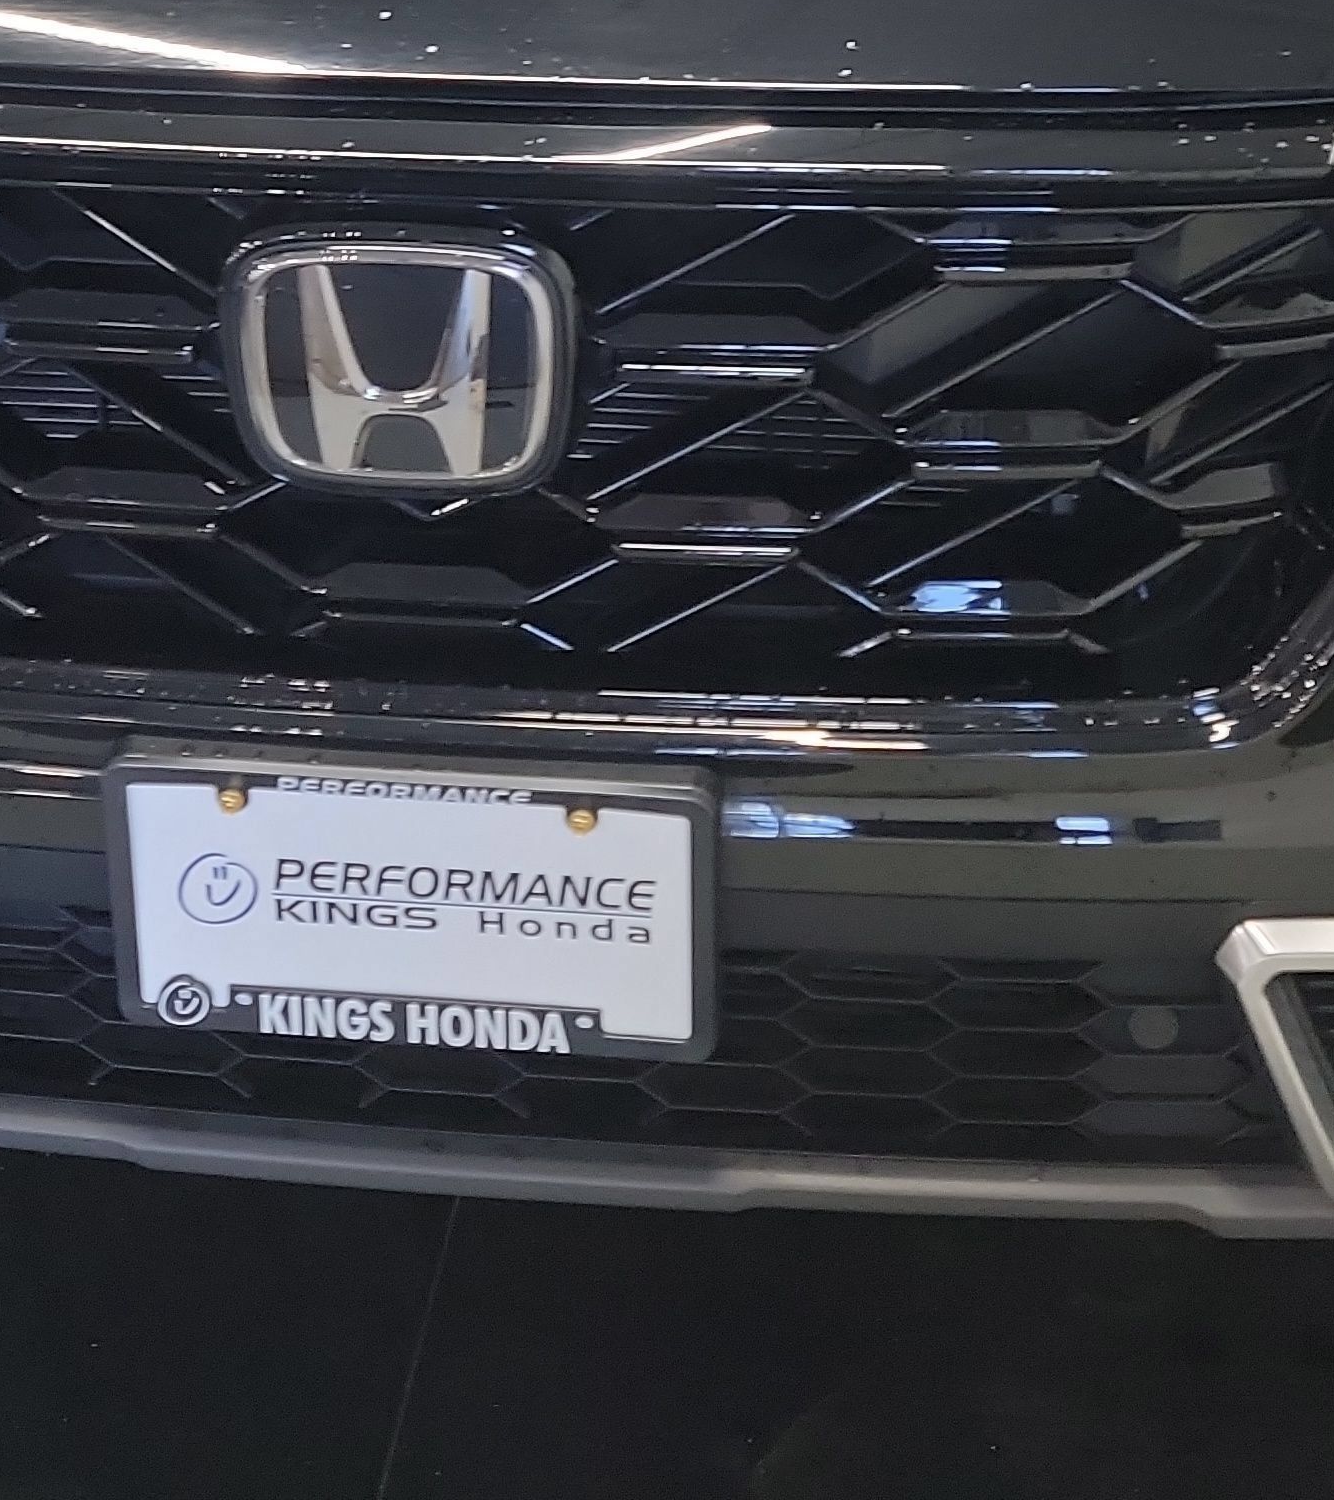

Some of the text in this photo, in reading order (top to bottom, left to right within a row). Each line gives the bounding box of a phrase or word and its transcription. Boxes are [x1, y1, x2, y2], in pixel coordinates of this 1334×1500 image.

[276, 775, 533, 805] PERFORMANCE
[274, 858, 657, 912] PERFORMANCE
[275, 898, 651, 944] KINGS Honda
[258, 992, 572, 1055] KINGS HONDA
